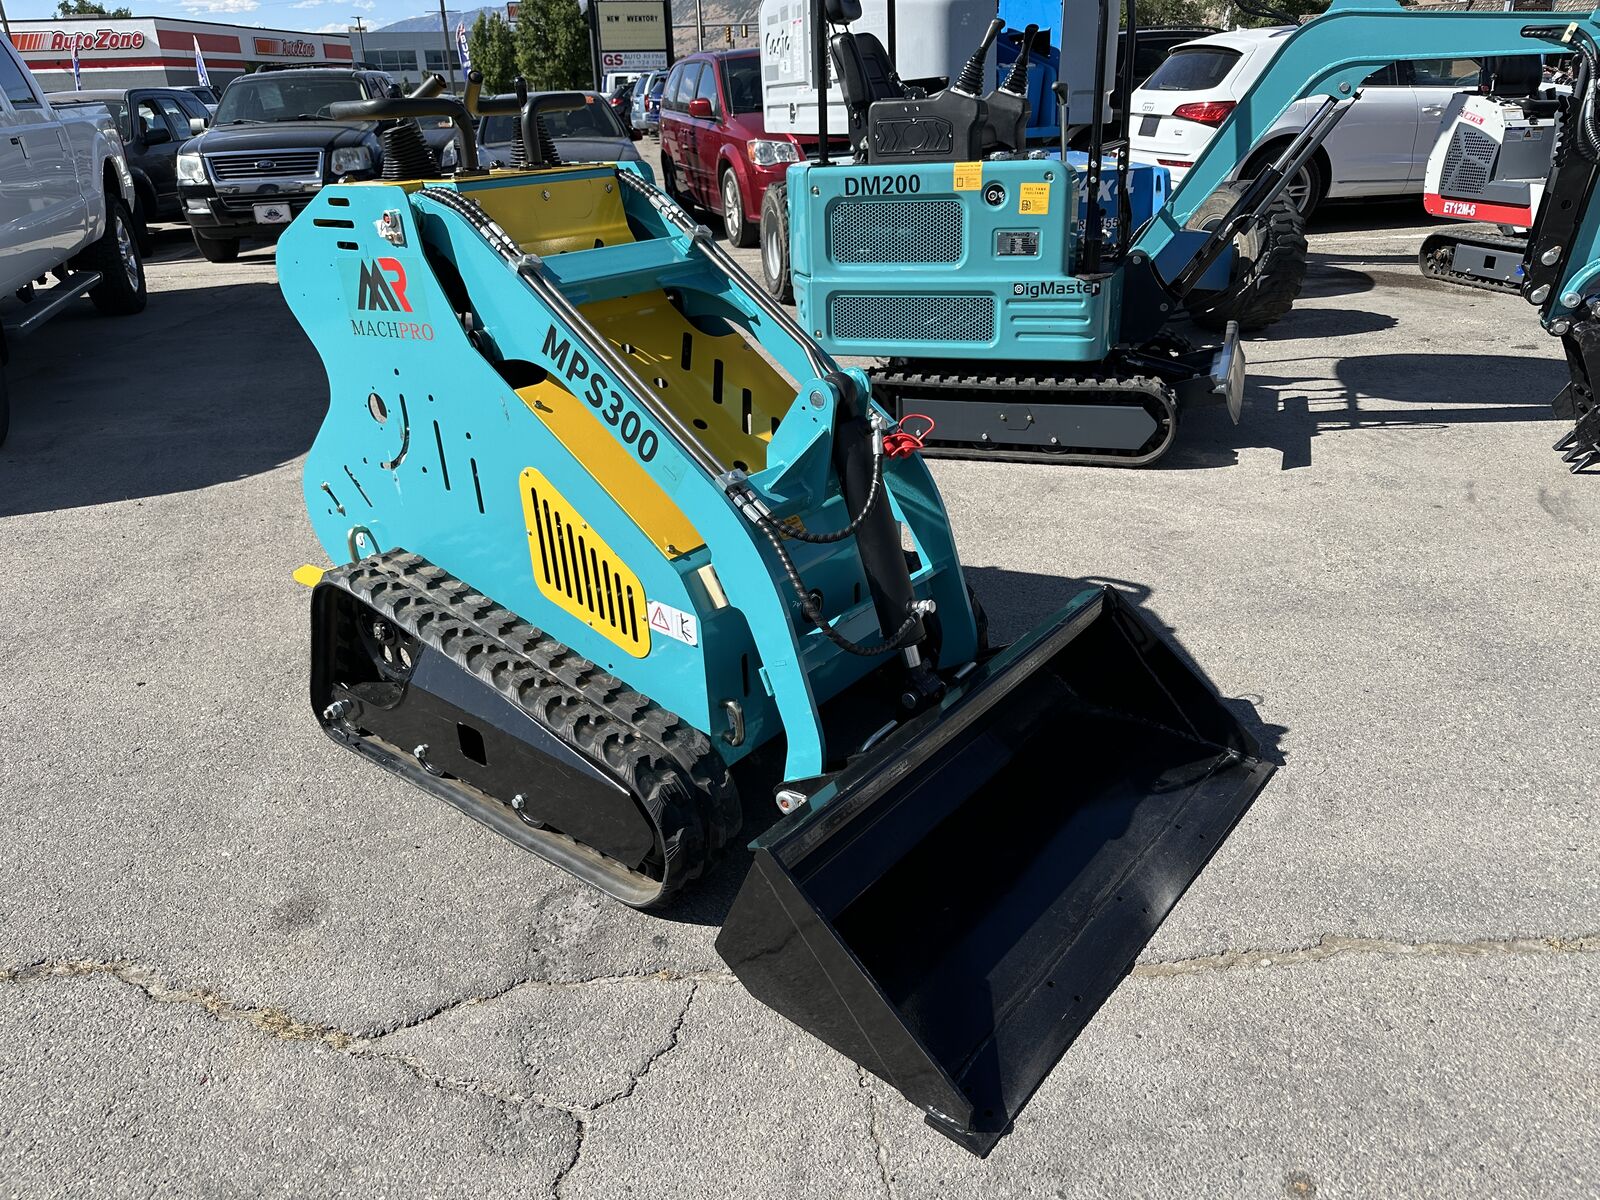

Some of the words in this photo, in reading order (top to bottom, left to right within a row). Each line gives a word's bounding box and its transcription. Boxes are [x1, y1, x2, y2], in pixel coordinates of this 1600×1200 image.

[51, 30, 144, 50] AutoZone
[282, 39, 315, 57] AutoZone
[460, 34, 470, 60] BUY
[603, 54, 624, 66] GS
[845, 174, 921, 196] DM200
[1443, 202, 1476, 216] ET12M-6
[1014, 281, 1101, 298] DigMaster
[351, 319, 434, 341] MACHPRO
[541, 323, 659, 463] MPS300
